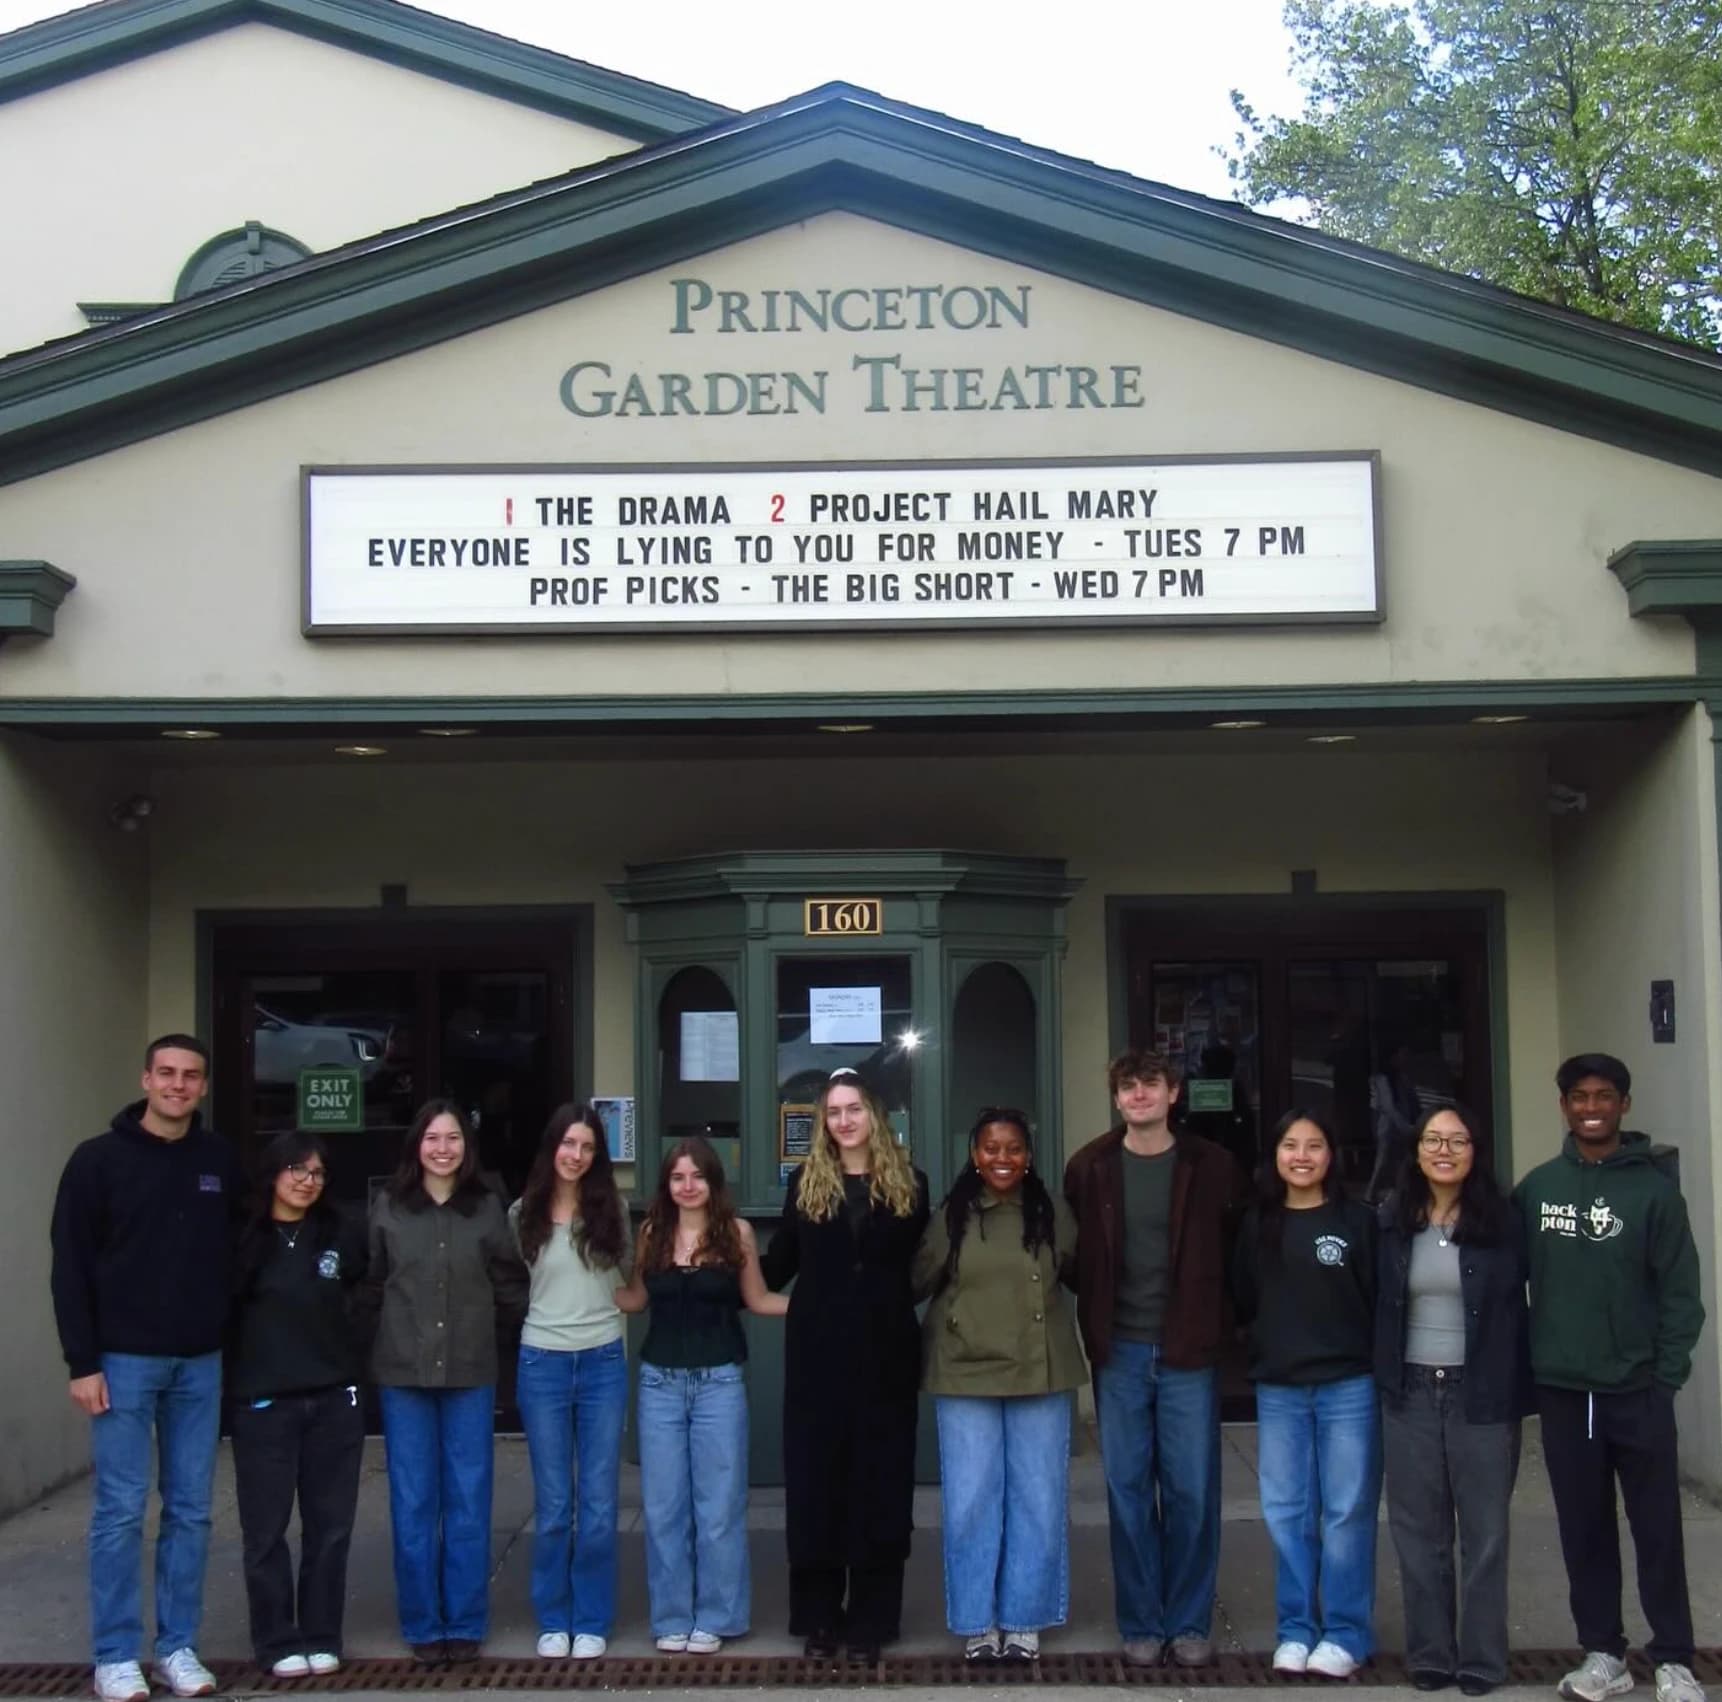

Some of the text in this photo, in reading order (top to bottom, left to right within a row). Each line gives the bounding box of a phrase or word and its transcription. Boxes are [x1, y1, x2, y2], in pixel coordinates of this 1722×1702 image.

[669, 278, 1031, 333] PRINCETON
[559, 353, 1146, 418] GARDEN THEATRE
[535, 496, 593, 526] THE
[618, 495, 731, 526] DRAMA
[771, 494, 785, 523] 2
[810, 492, 952, 523] PROJECT
[974, 491, 1049, 521] HAIL
[1067, 489, 1158, 519] MARY
[368, 537, 530, 567] EVERYONE
[561, 537, 590, 566] IS
[617, 535, 712, 566] LYING
[734, 535, 773, 564] TO
[793, 533, 854, 564] YOU
[878, 532, 936, 562] FOR
[957, 530, 1064, 561] MONEY
[1123, 528, 1202, 558] TUES
[1223, 527, 1241, 557] 7
[1259, 525, 1305, 556] PM
[530, 577, 608, 606] PROF
[626, 575, 719, 605] PICKS
[771, 574, 829, 603] THE
[846, 573, 900, 602] BIG
[914, 571, 1014, 601] SHORT
[1053, 570, 1119, 599] WED
[1132, 570, 1148, 598] 7
[1158, 568, 1204, 597] PM
[816, 903, 871, 931] 160
[306, 1094, 352, 1108] ONLY
[310, 1079, 350, 1092] EXIT
